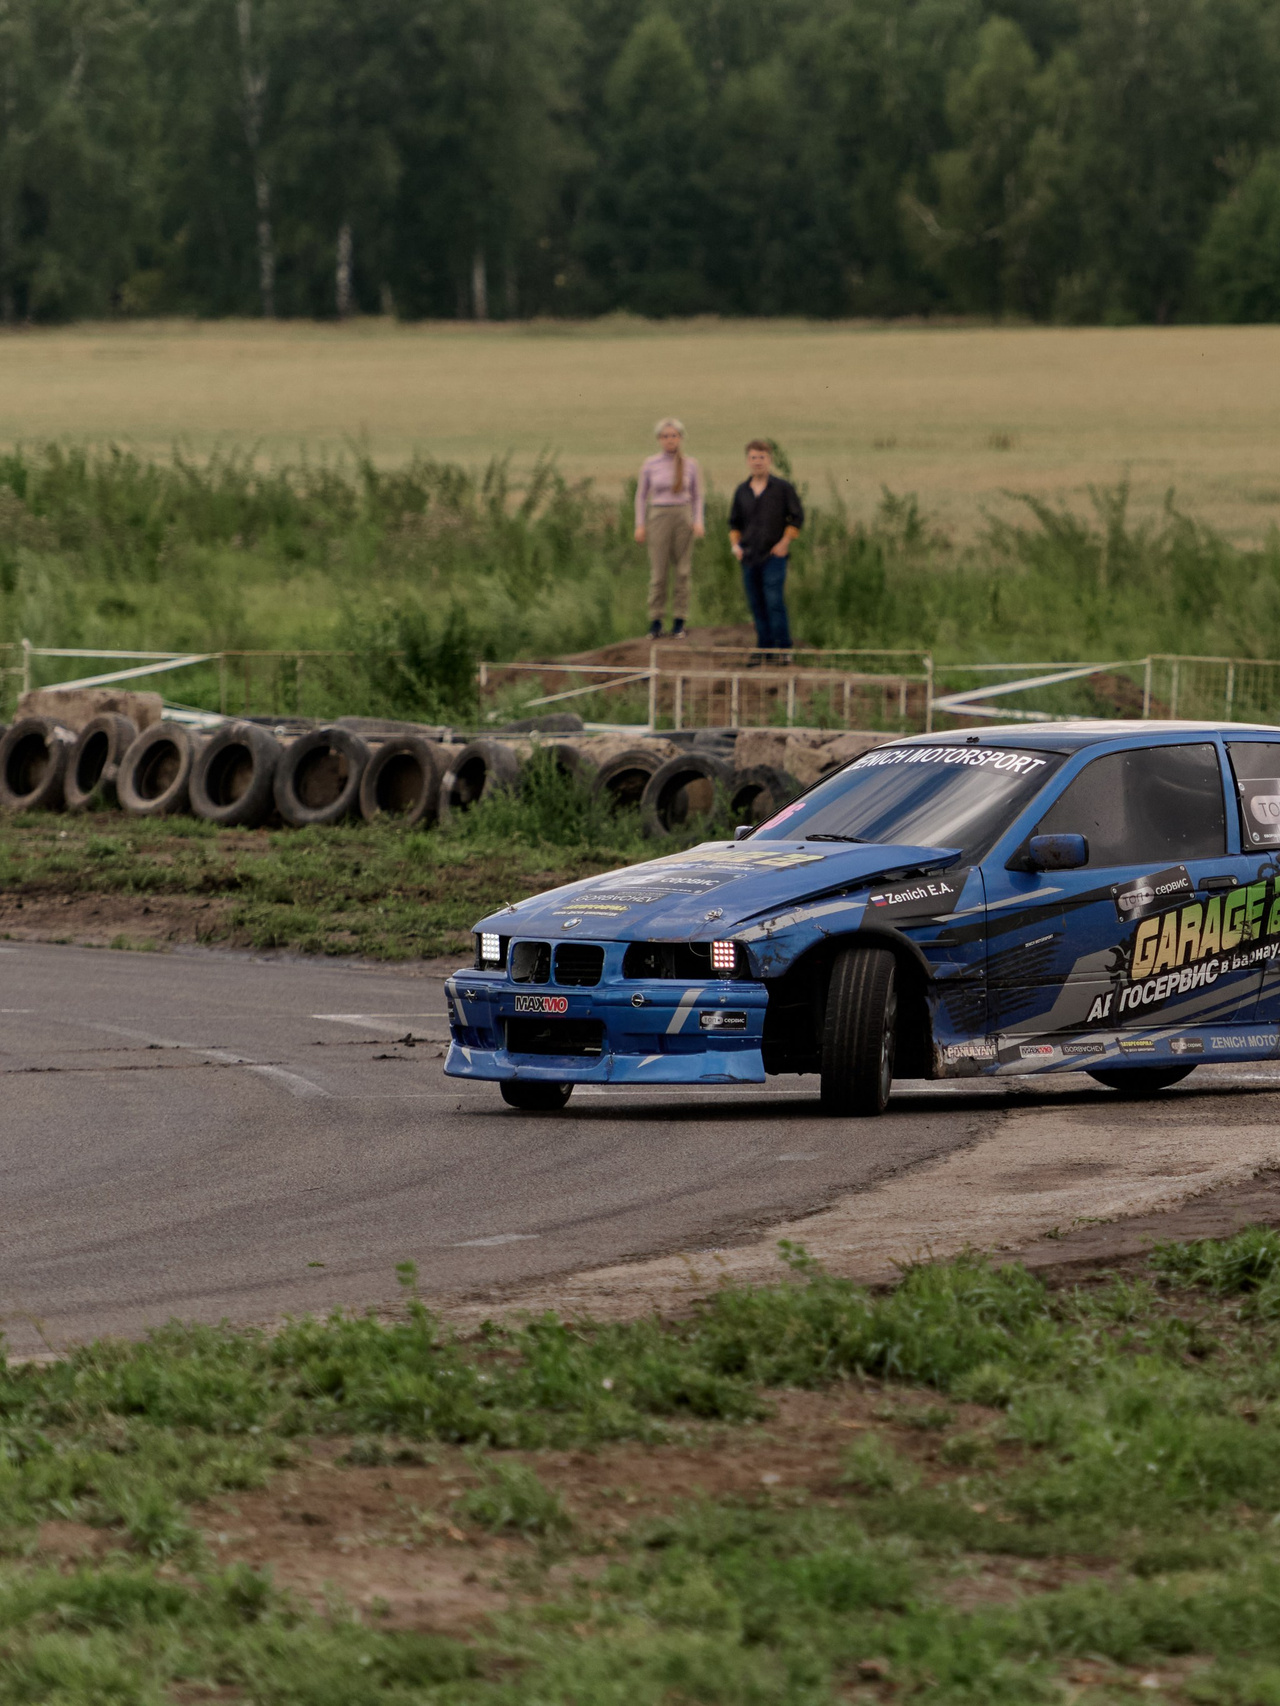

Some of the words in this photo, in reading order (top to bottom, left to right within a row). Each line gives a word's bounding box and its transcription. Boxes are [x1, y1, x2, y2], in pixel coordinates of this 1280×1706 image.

[904, 748, 1046, 775] MOTORSPORT
[885, 887, 928, 905] Zenich
[927, 882, 954, 896] E.A.
[1122, 893, 1145, 907] ТОП
[1155, 877, 1189, 896] сервис
[1131, 880, 1267, 981] GARAGE
[515, 995, 568, 1014] MAXMO
[1210, 1036, 1247, 1049] ZENICH
